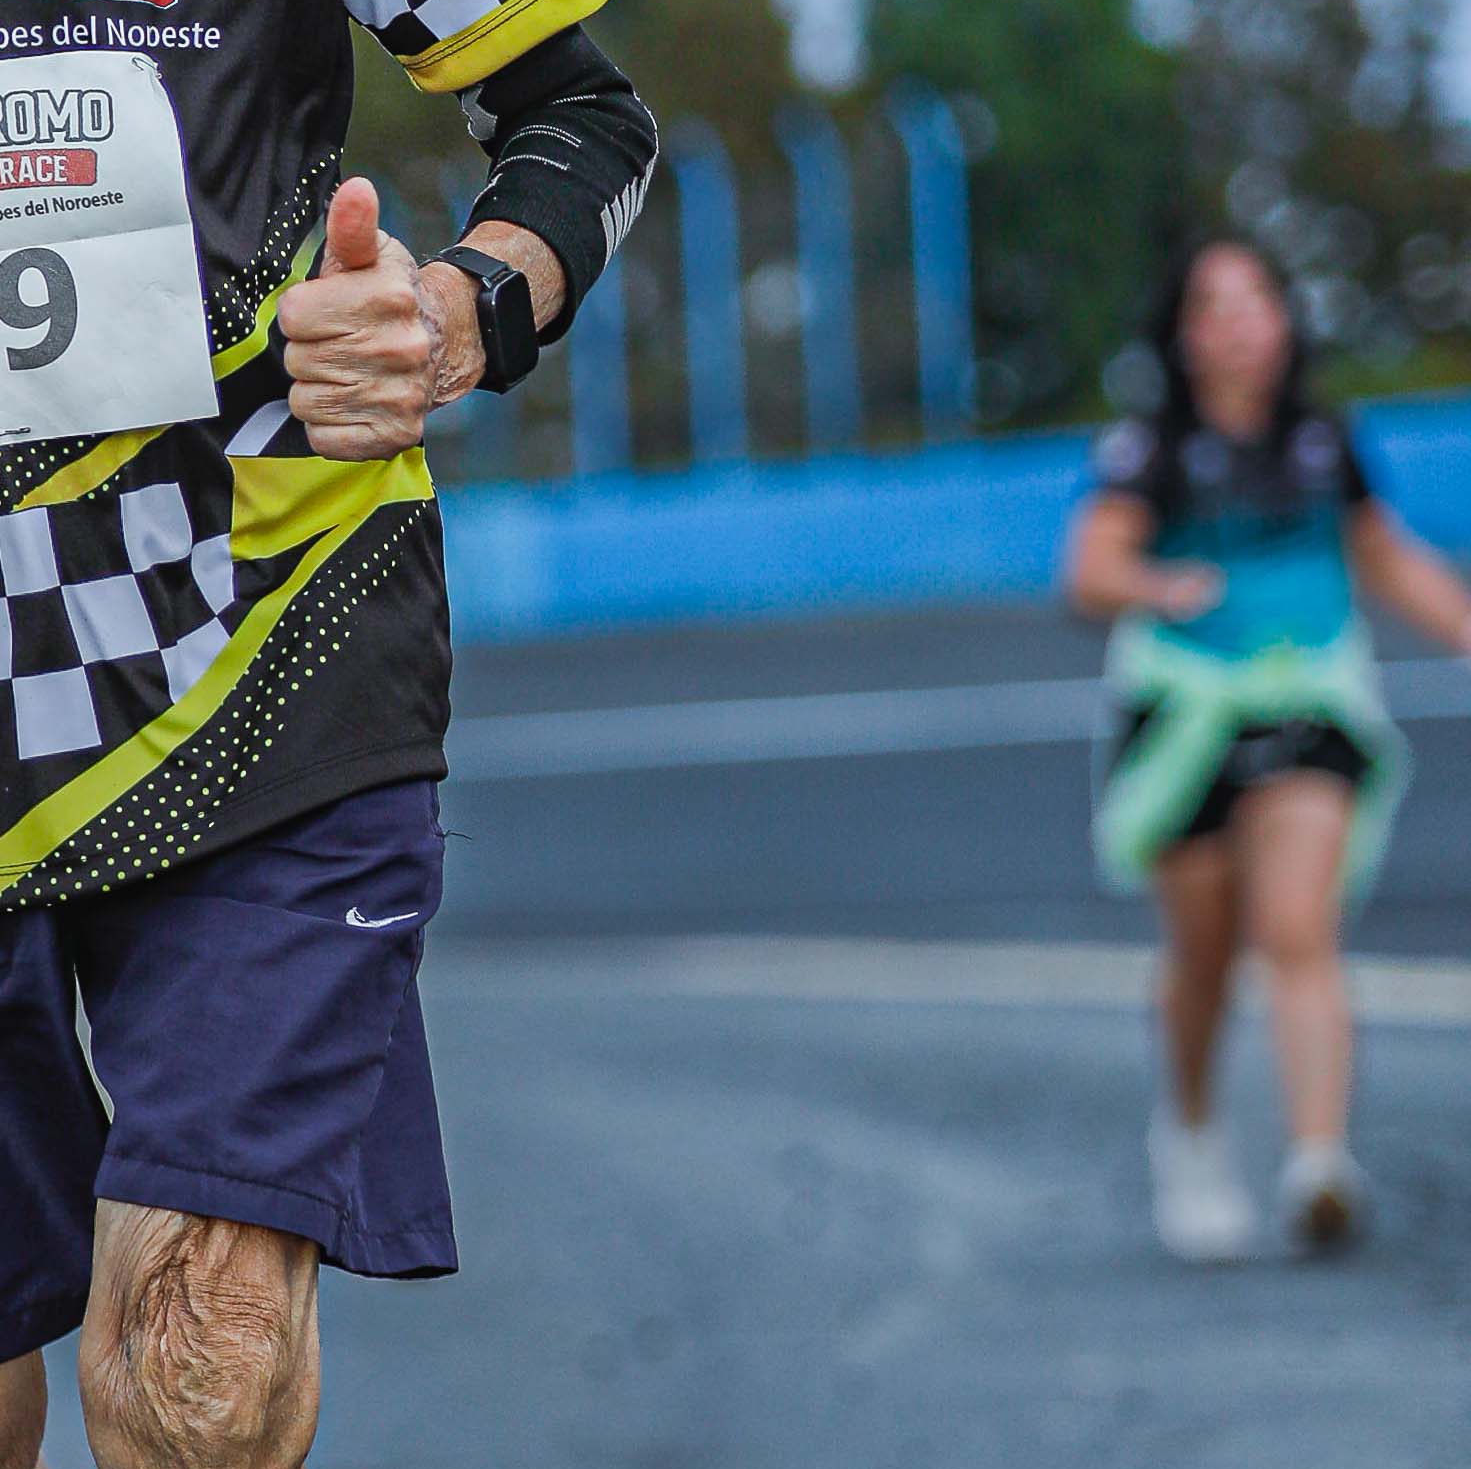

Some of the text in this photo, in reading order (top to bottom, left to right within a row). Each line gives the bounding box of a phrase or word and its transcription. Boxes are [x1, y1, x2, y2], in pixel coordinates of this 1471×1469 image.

[52, 15, 97, 46] del
[27, 197, 49, 216] del
[53, 191, 124, 213] Noroeste
